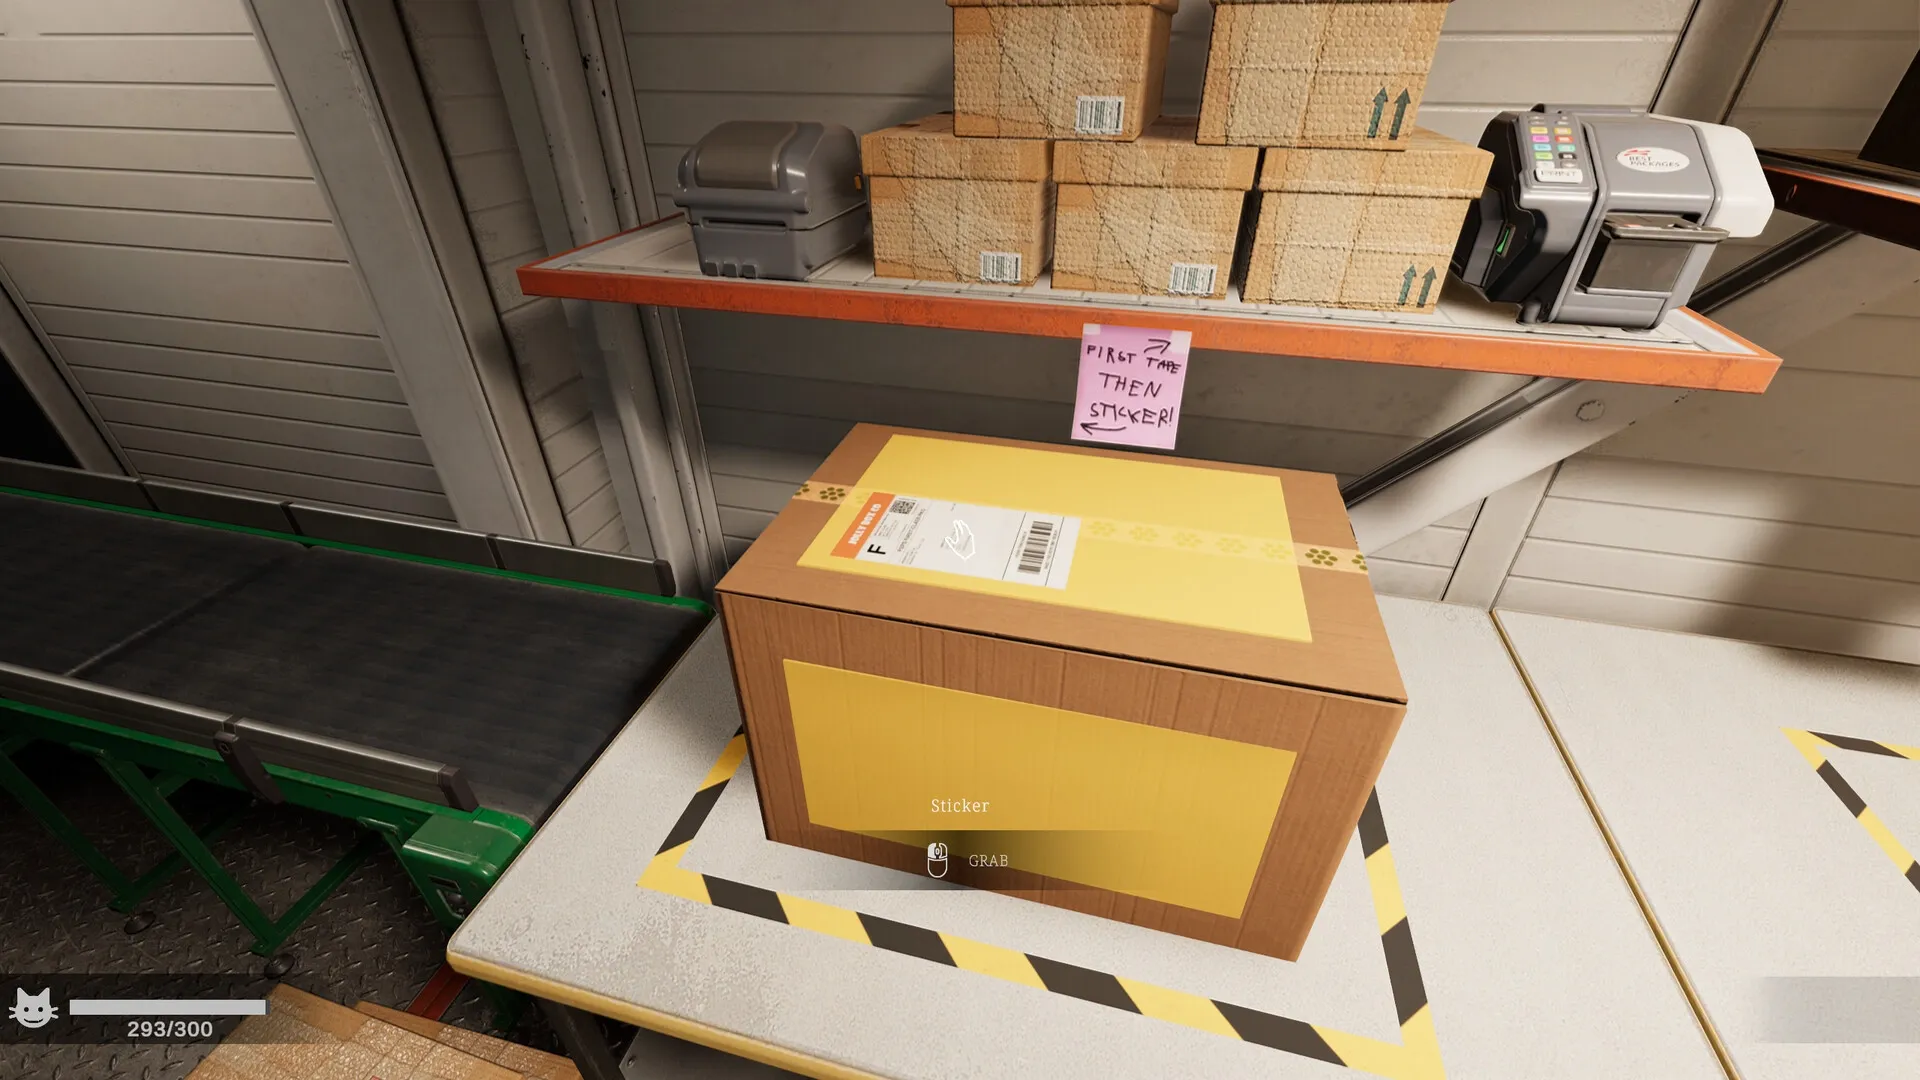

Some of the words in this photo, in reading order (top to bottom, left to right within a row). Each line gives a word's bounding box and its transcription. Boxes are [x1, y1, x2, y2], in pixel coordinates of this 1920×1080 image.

[1630, 160, 1681, 168] PACKAGES
[1086, 344, 1137, 364] FIRST
[1098, 371, 1162, 398] THEN
[1089, 402, 1174, 428] STICKER!
[866, 543, 887, 555] F
